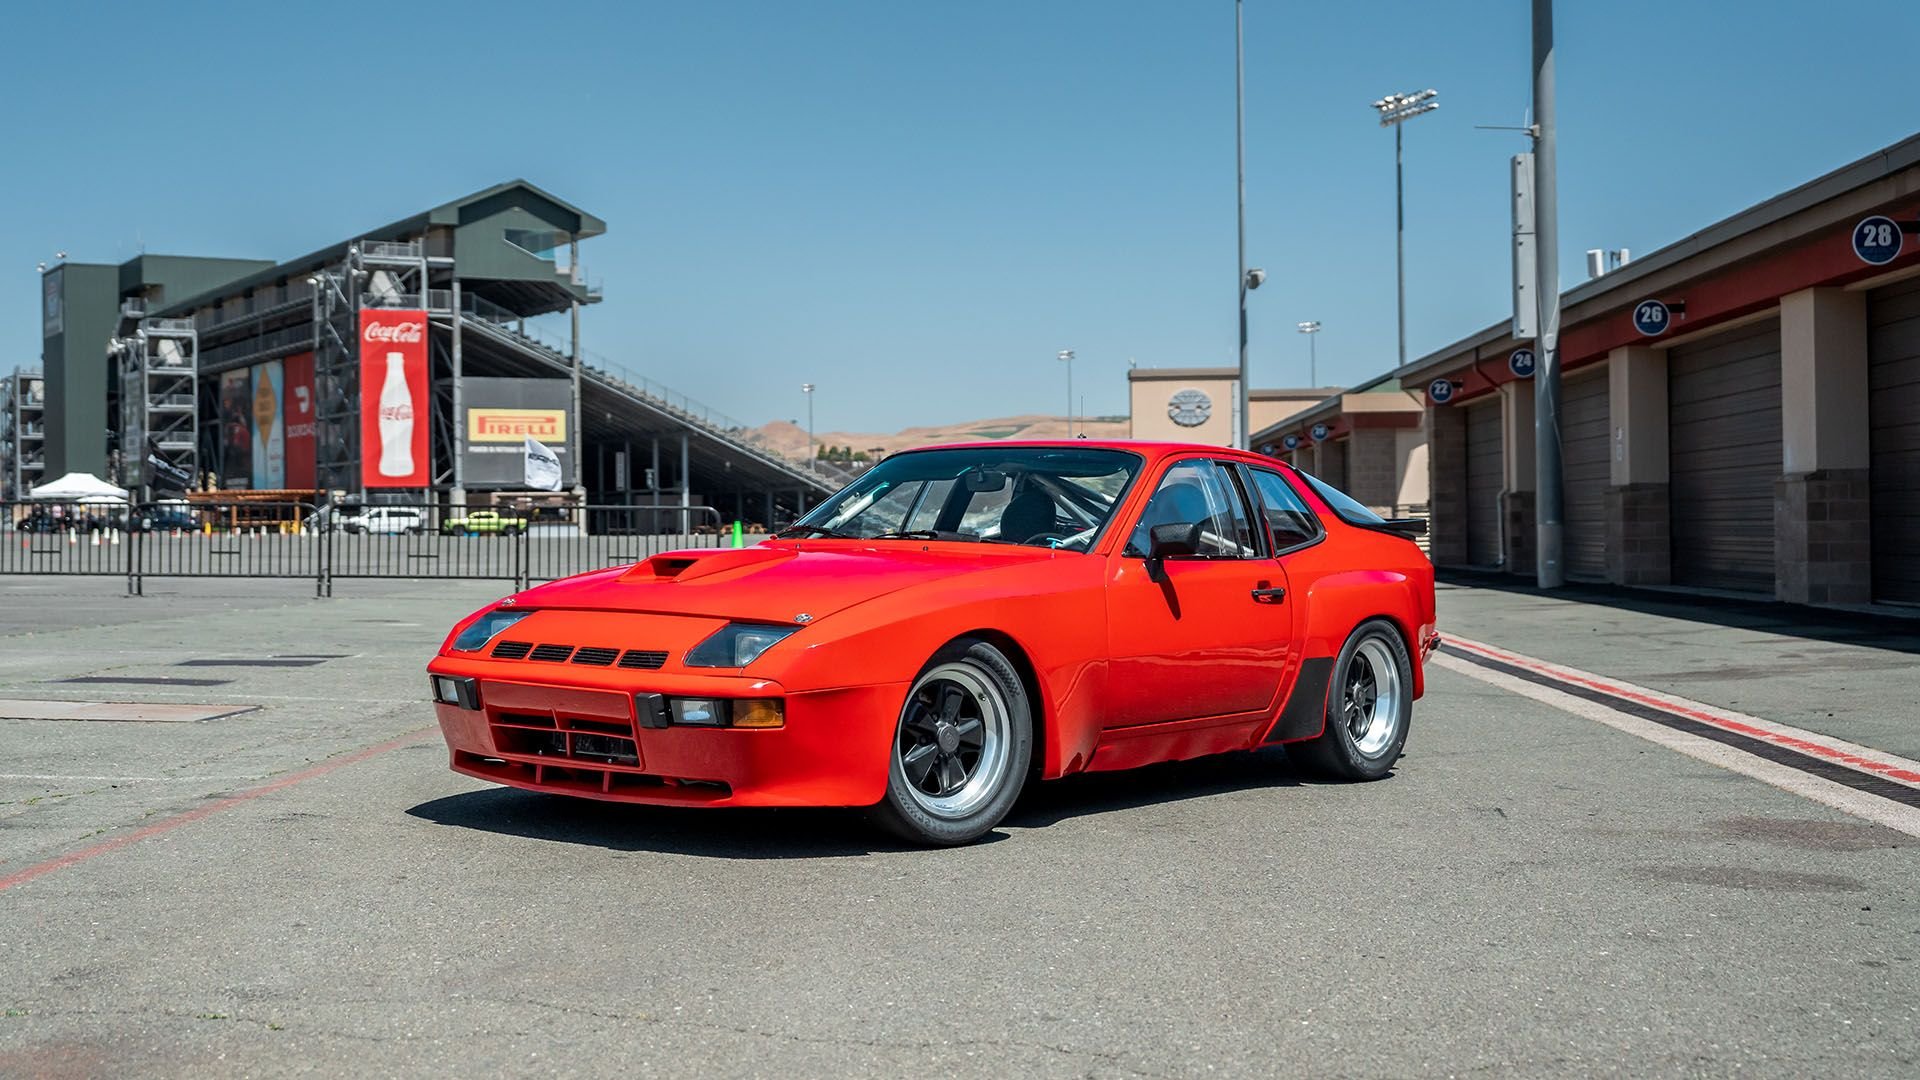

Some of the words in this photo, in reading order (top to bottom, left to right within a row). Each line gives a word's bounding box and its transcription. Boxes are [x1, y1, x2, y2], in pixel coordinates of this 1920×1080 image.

[1863, 224, 1892, 247] 28
[1641, 306, 1662, 322] 26
[364, 321, 422, 343] Coca-Cola
[1515, 354, 1532, 368] 24
[1433, 383, 1448, 395] 22
[478, 415, 557, 435] PIRELLI
